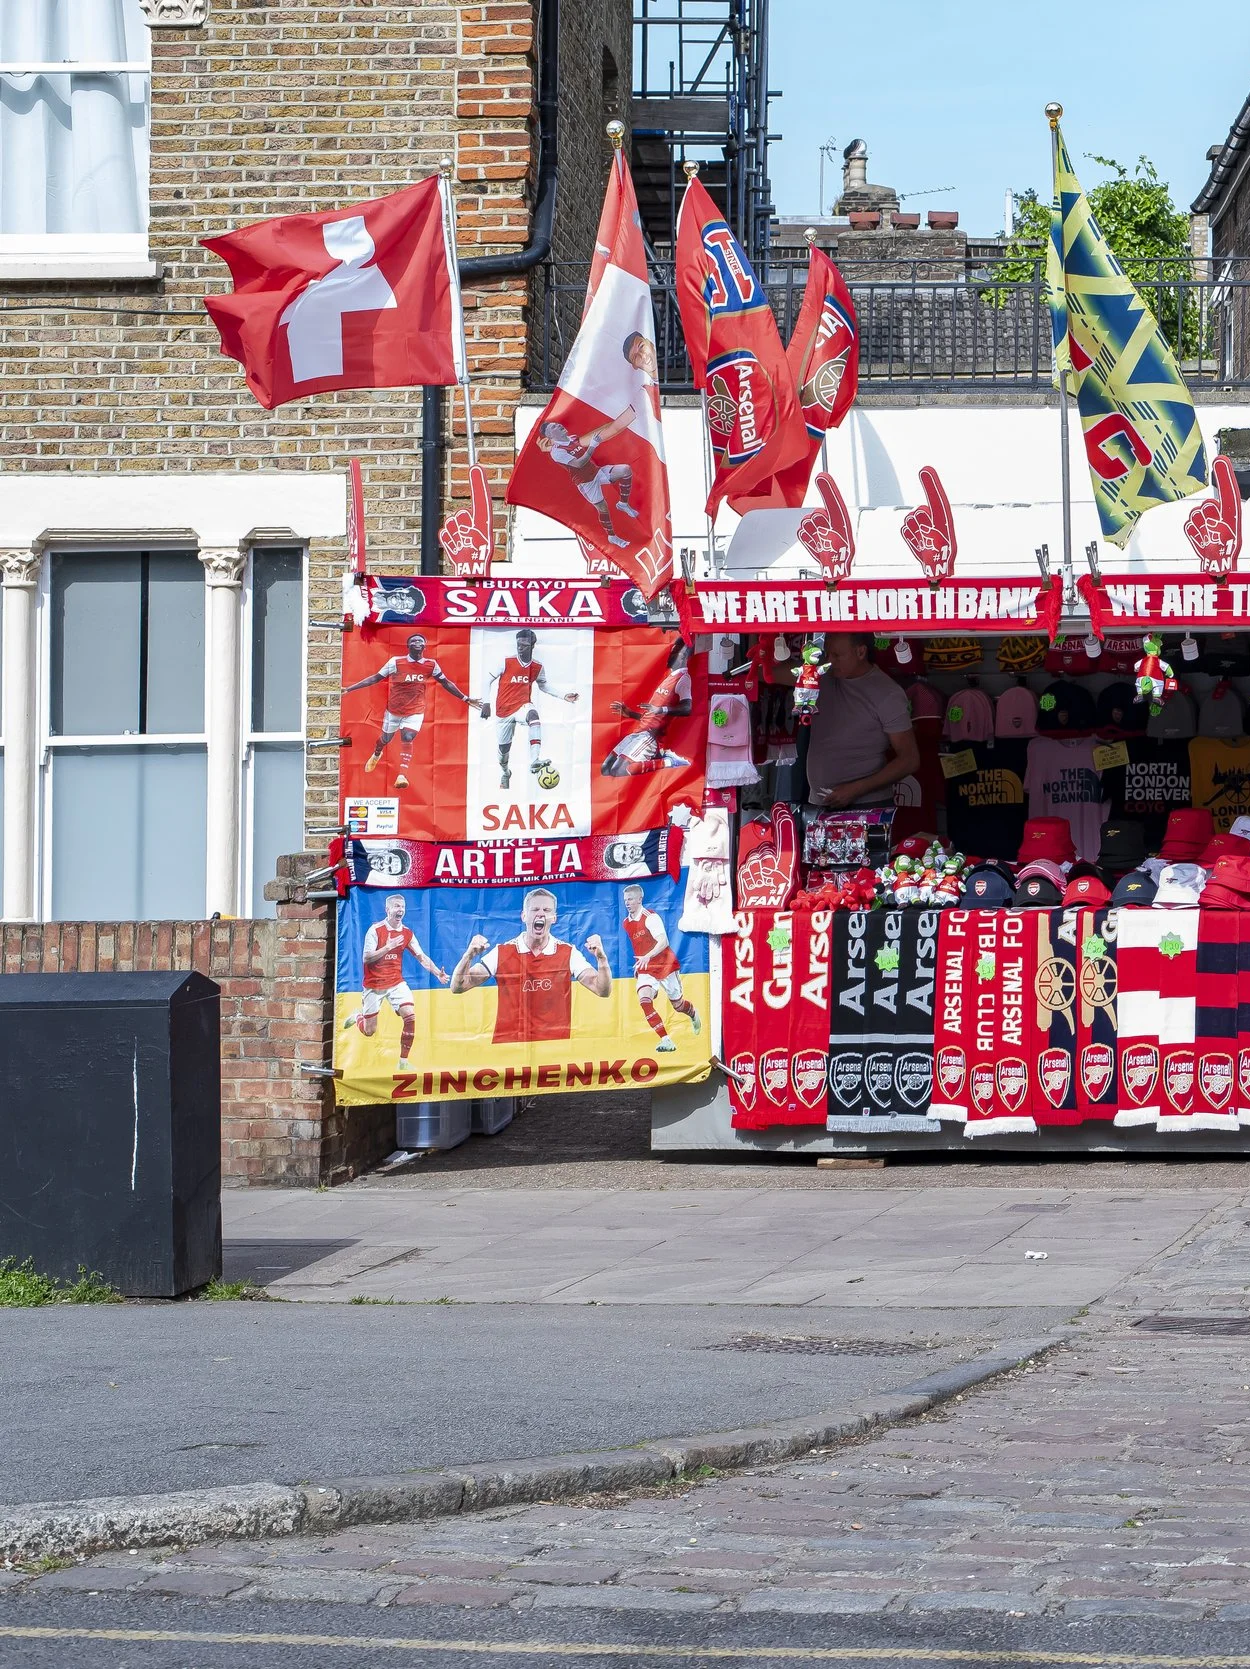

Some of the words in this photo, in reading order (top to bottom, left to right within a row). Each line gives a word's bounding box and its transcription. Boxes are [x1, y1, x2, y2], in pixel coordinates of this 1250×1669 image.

[723, 248, 741, 275] SINCE
[734, 364, 762, 450] Arsenal
[471, 545, 485, 560] #1
[933, 545, 948, 561] #1
[1219, 539, 1233, 556] #1
[831, 547, 847, 562] #1
[457, 562, 485, 575] FAN
[1203, 556, 1232, 573] FAN
[483, 580, 566, 590] BUKAYO
[446, 589, 603, 617] SAKA
[698, 590, 745, 623] WE
[745, 590, 800, 623] ARE
[802, 589, 857, 622] THE
[857, 588, 955, 621] NORTH
[958, 586, 1042, 620] BANK
[1105, 584, 1151, 618] WE
[1161, 583, 1218, 617] ARE
[405, 674, 424, 682] AFC
[510, 675, 529, 684] AFC
[655, 688, 669, 696] AFC
[976, 769, 1001, 782] THE
[1060, 768, 1085, 781] THE
[1125, 763, 1178, 775] NORTH
[959, 781, 999, 796] NORTH
[1043, 780, 1084, 793] NORTH
[1125, 776, 1190, 788] LONDON
[969, 793, 1001, 806] BANK
[1052, 791, 1084, 803] BANK
[1125, 788, 1190, 801] FOREVER
[1123, 801, 1165, 813] COYG
[482, 803, 575, 831] SAKA
[1218, 817, 1230, 828] IS
[477, 838, 542, 848] MIKEL
[659, 829, 668, 850] ARTETA
[434, 843, 582, 877] ARTETA
[658, 851, 667, 872] MIKEL
[541, 872, 576, 880] ARTETA
[769, 883, 787, 895] #1
[747, 895, 782, 906] FAN
[522, 979, 552, 992] AFC
[943, 946, 964, 1034] ARSENAL
[1001, 956, 1023, 1045] ARSENAL
[976, 994, 995, 1051] CLUB
[798, 1058, 825, 1070] Arsenal
[1086, 1052, 1109, 1064] Arsenal
[1127, 1053, 1154, 1066] Arsenal
[902, 1061, 930, 1072] Arsenal
[391, 1057, 659, 1099] ZINCHENKO
